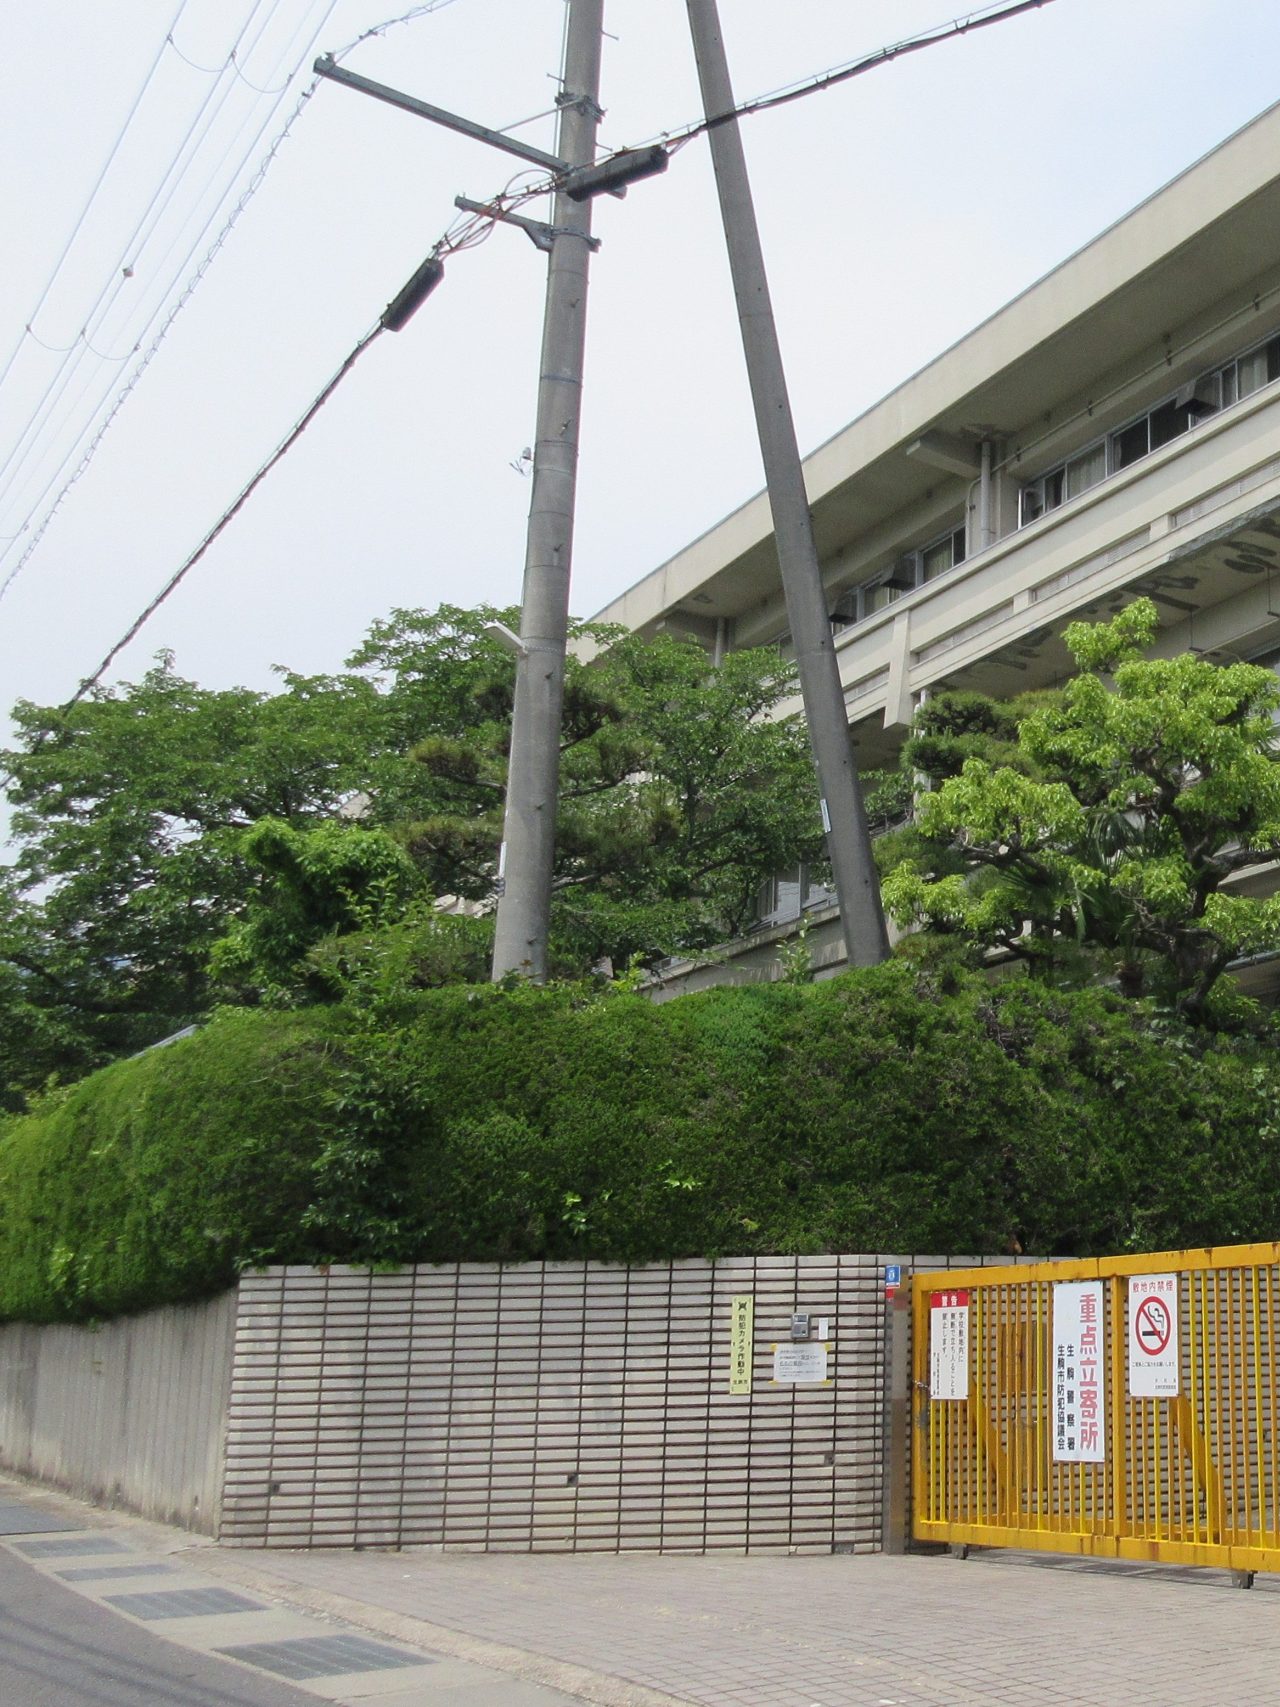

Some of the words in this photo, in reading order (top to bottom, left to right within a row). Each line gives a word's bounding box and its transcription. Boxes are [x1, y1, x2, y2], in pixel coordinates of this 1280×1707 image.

[1133, 1280, 1174, 1293] 敷地内禁煙
[1066, 1344, 1075, 1451] 生駒警察署
[1079, 1293, 1099, 1452] 重点立寄所
